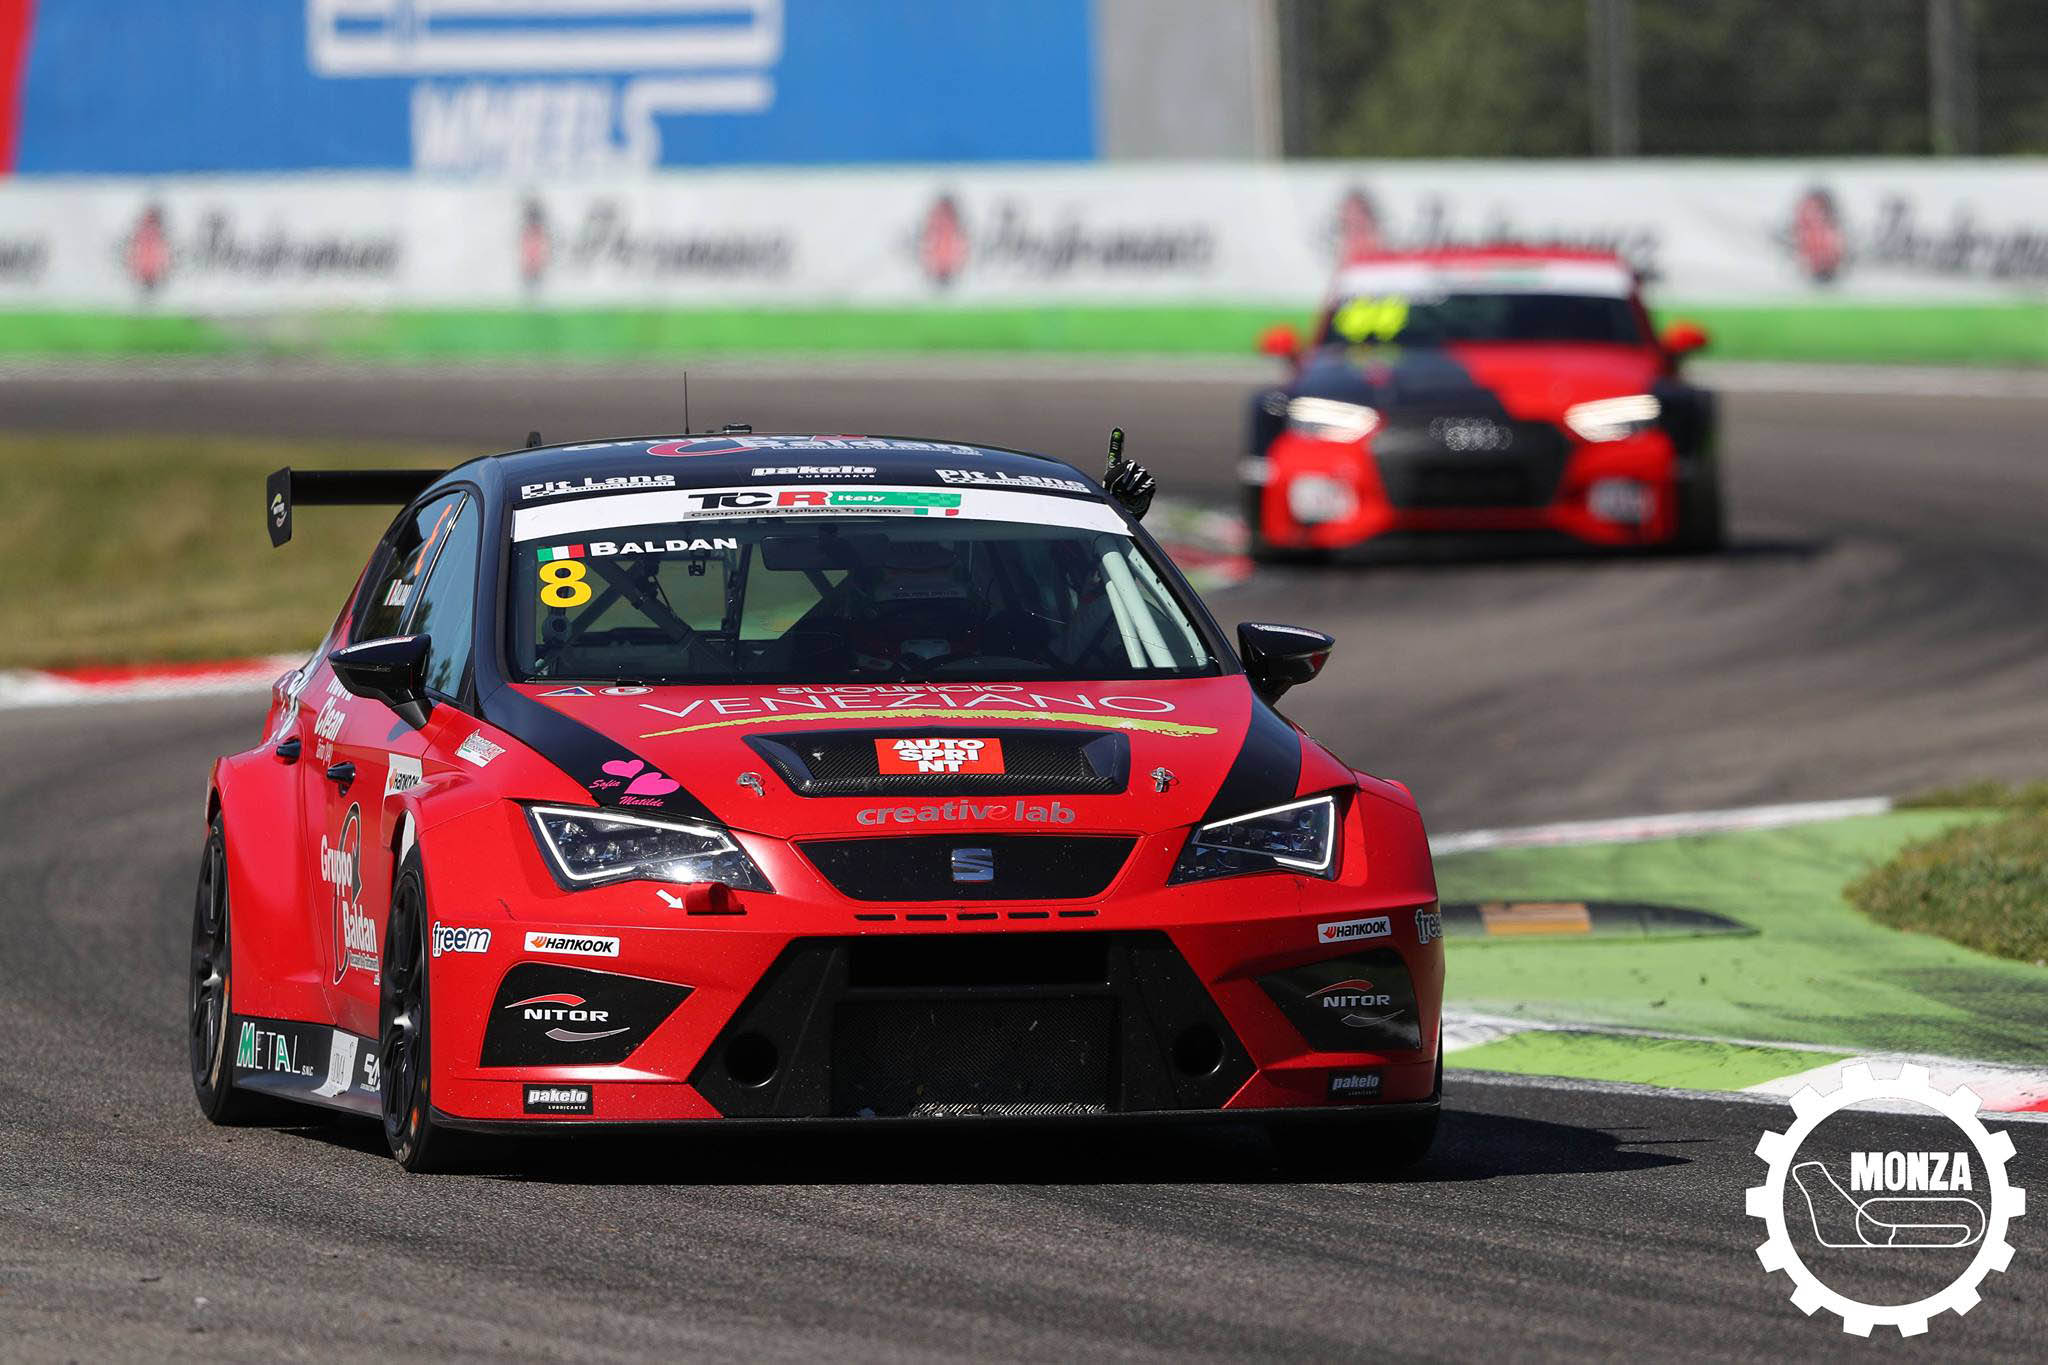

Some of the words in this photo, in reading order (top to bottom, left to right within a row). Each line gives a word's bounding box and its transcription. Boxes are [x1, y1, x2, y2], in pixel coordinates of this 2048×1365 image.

[752, 466, 877, 477] pakelo
[935, 469, 989, 482] Pit
[996, 472, 1087, 488] Lane
[521, 481, 572, 495] Pit
[584, 475, 675, 487] Lane
[688, 491, 832, 510] TCR
[837, 494, 885, 503] Italy
[691, 509, 779, 518] Campionato
[784, 507, 838, 515] Italiano
[842, 507, 902, 515] Turismo
[589, 537, 738, 557] BALDAN
[539, 559, 592, 608] 8
[639, 693, 1176, 718] VENEZIANO
[892, 739, 985, 750] AUTO
[899, 749, 979, 761] SPRI
[918, 760, 963, 773] NT
[588, 779, 621, 790] Sofia
[619, 795, 664, 807] Matilde
[856, 799, 1012, 825] creative
[1014, 800, 1076, 824] lab
[320, 834, 353, 898] Gruppo
[342, 900, 377, 953] Baldan
[433, 921, 490, 956] freem
[1323, 994, 1390, 1008] NITOR
[524, 1008, 609, 1022] NITOR
[236, 1021, 301, 1074] METAL
[1332, 1074, 1379, 1090] pakelo
[528, 1088, 588, 1104] pakelo
